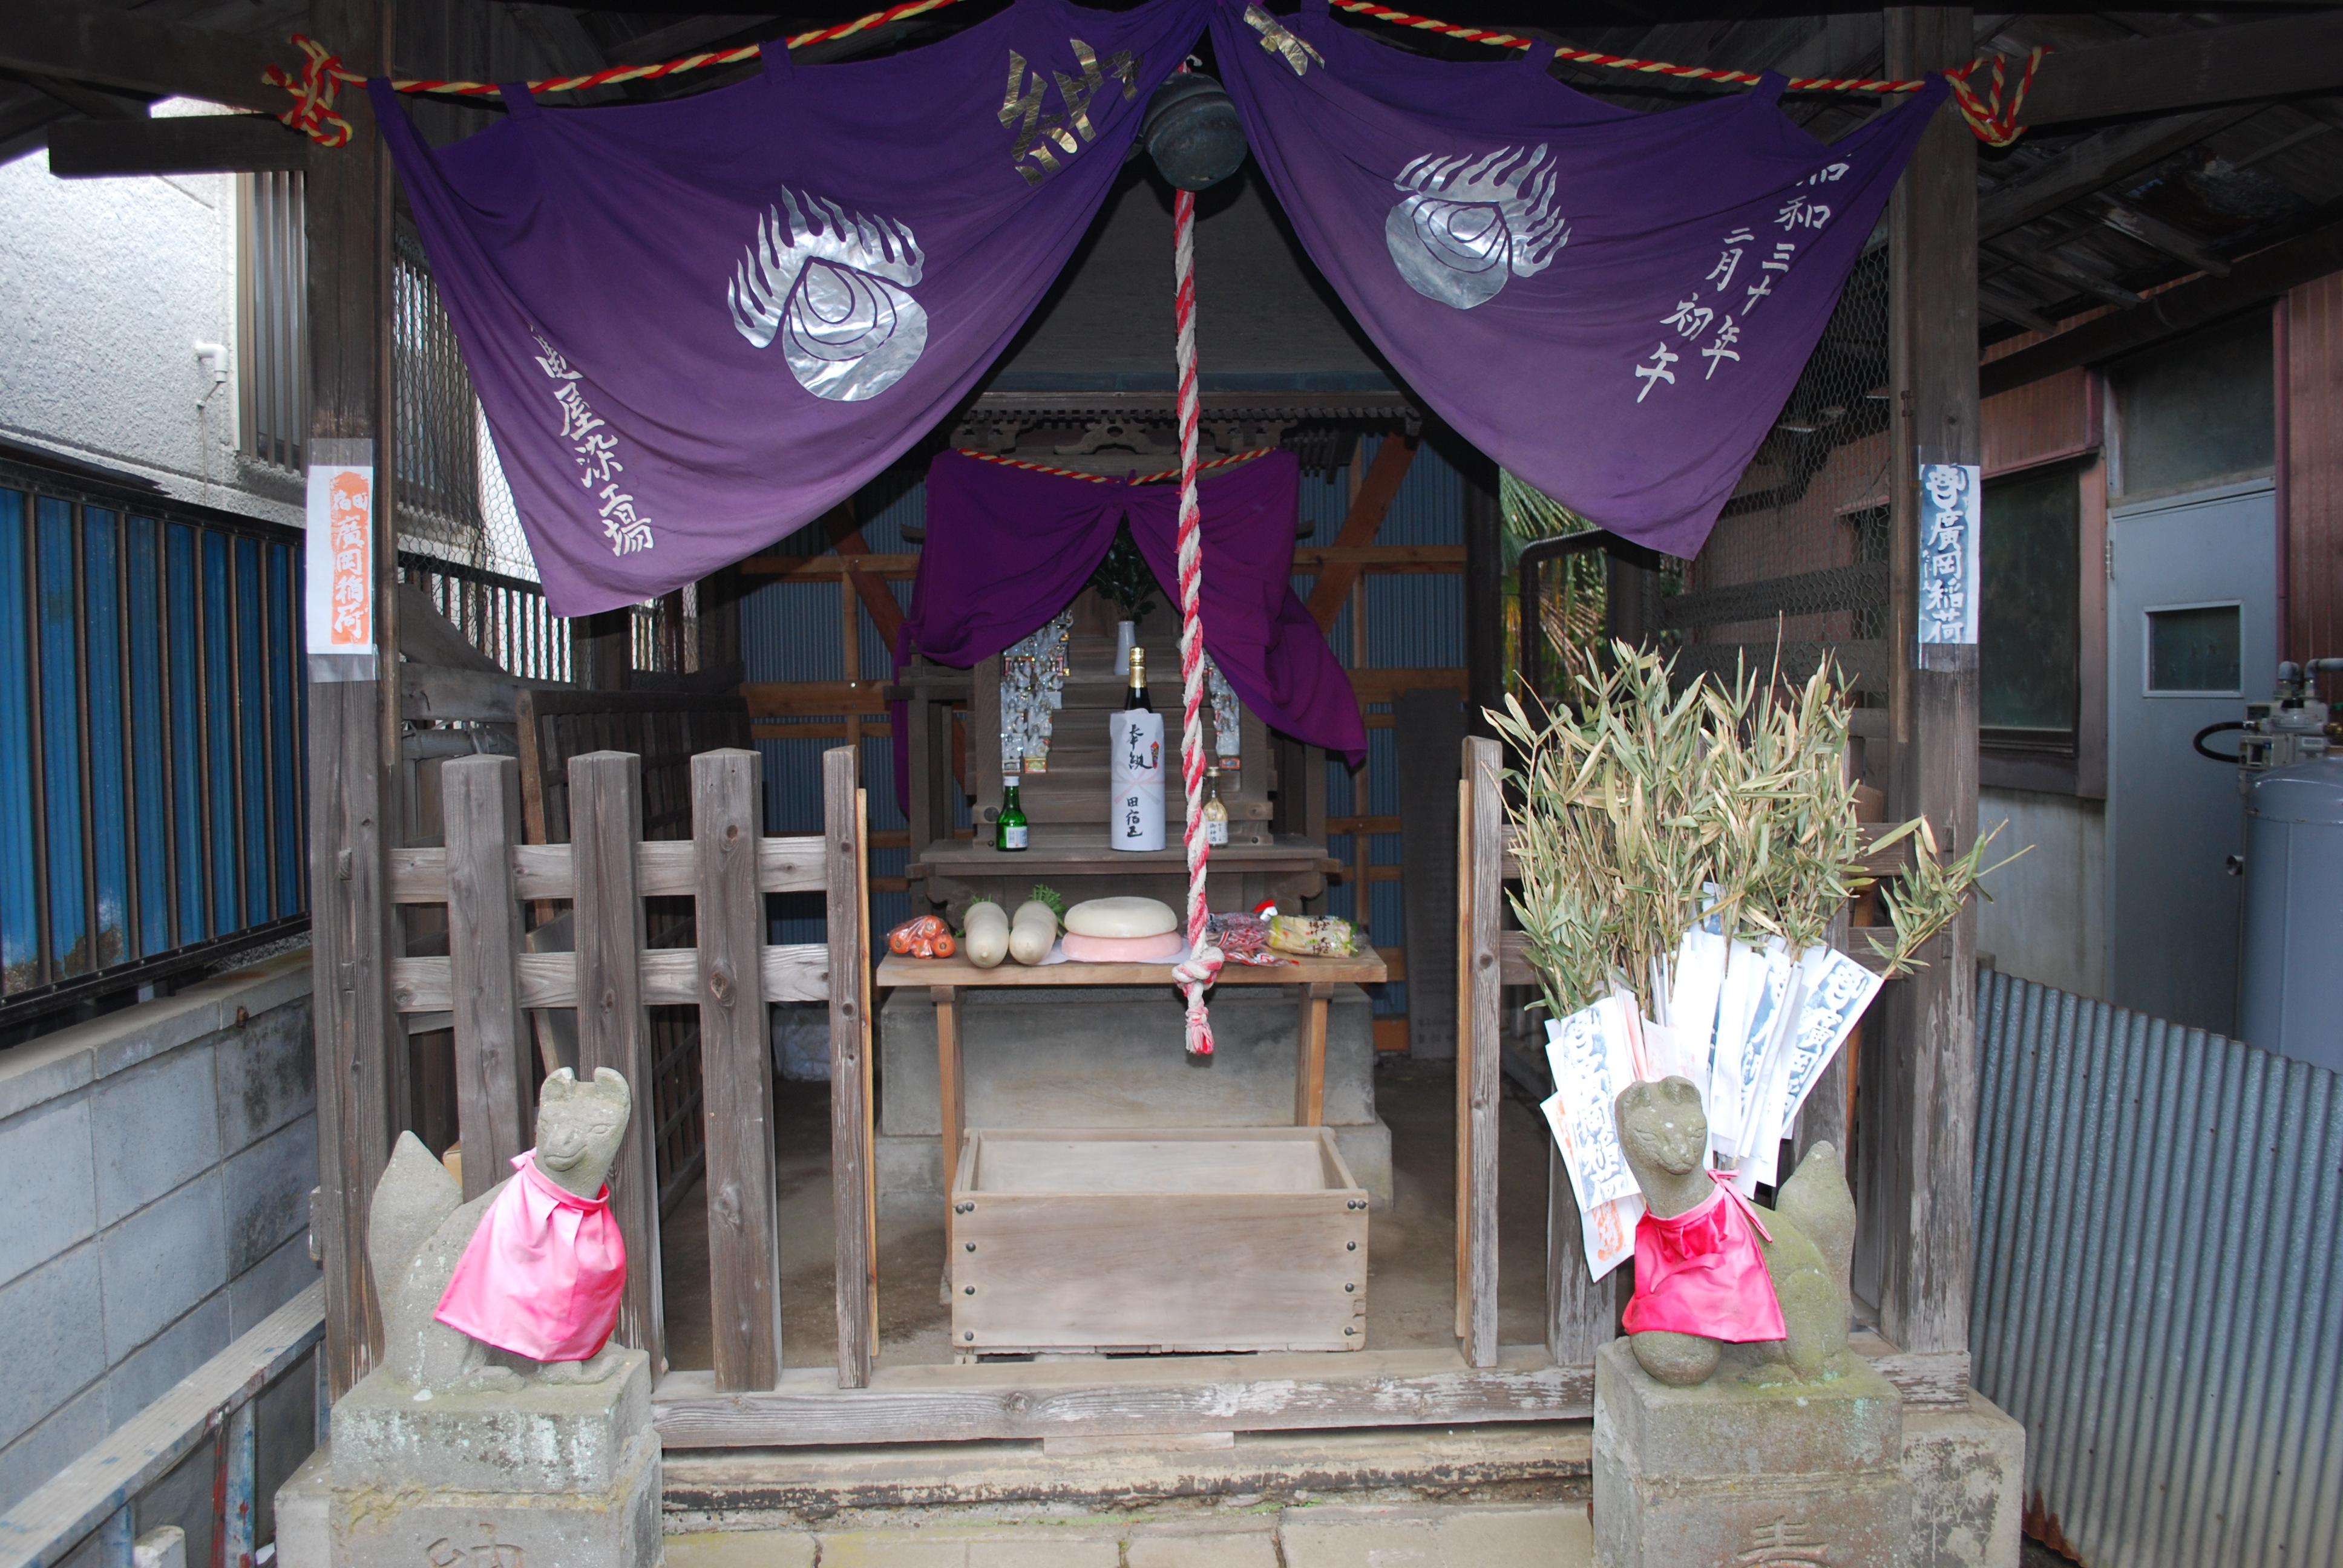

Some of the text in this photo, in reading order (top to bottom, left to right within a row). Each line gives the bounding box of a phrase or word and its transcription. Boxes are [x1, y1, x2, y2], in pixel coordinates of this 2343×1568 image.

[1635, 227, 1754, 403] 二月初午
[334, 515, 367, 639] 廣岡稲荷
[1925, 508, 1965, 642] 廣岡稲荷
